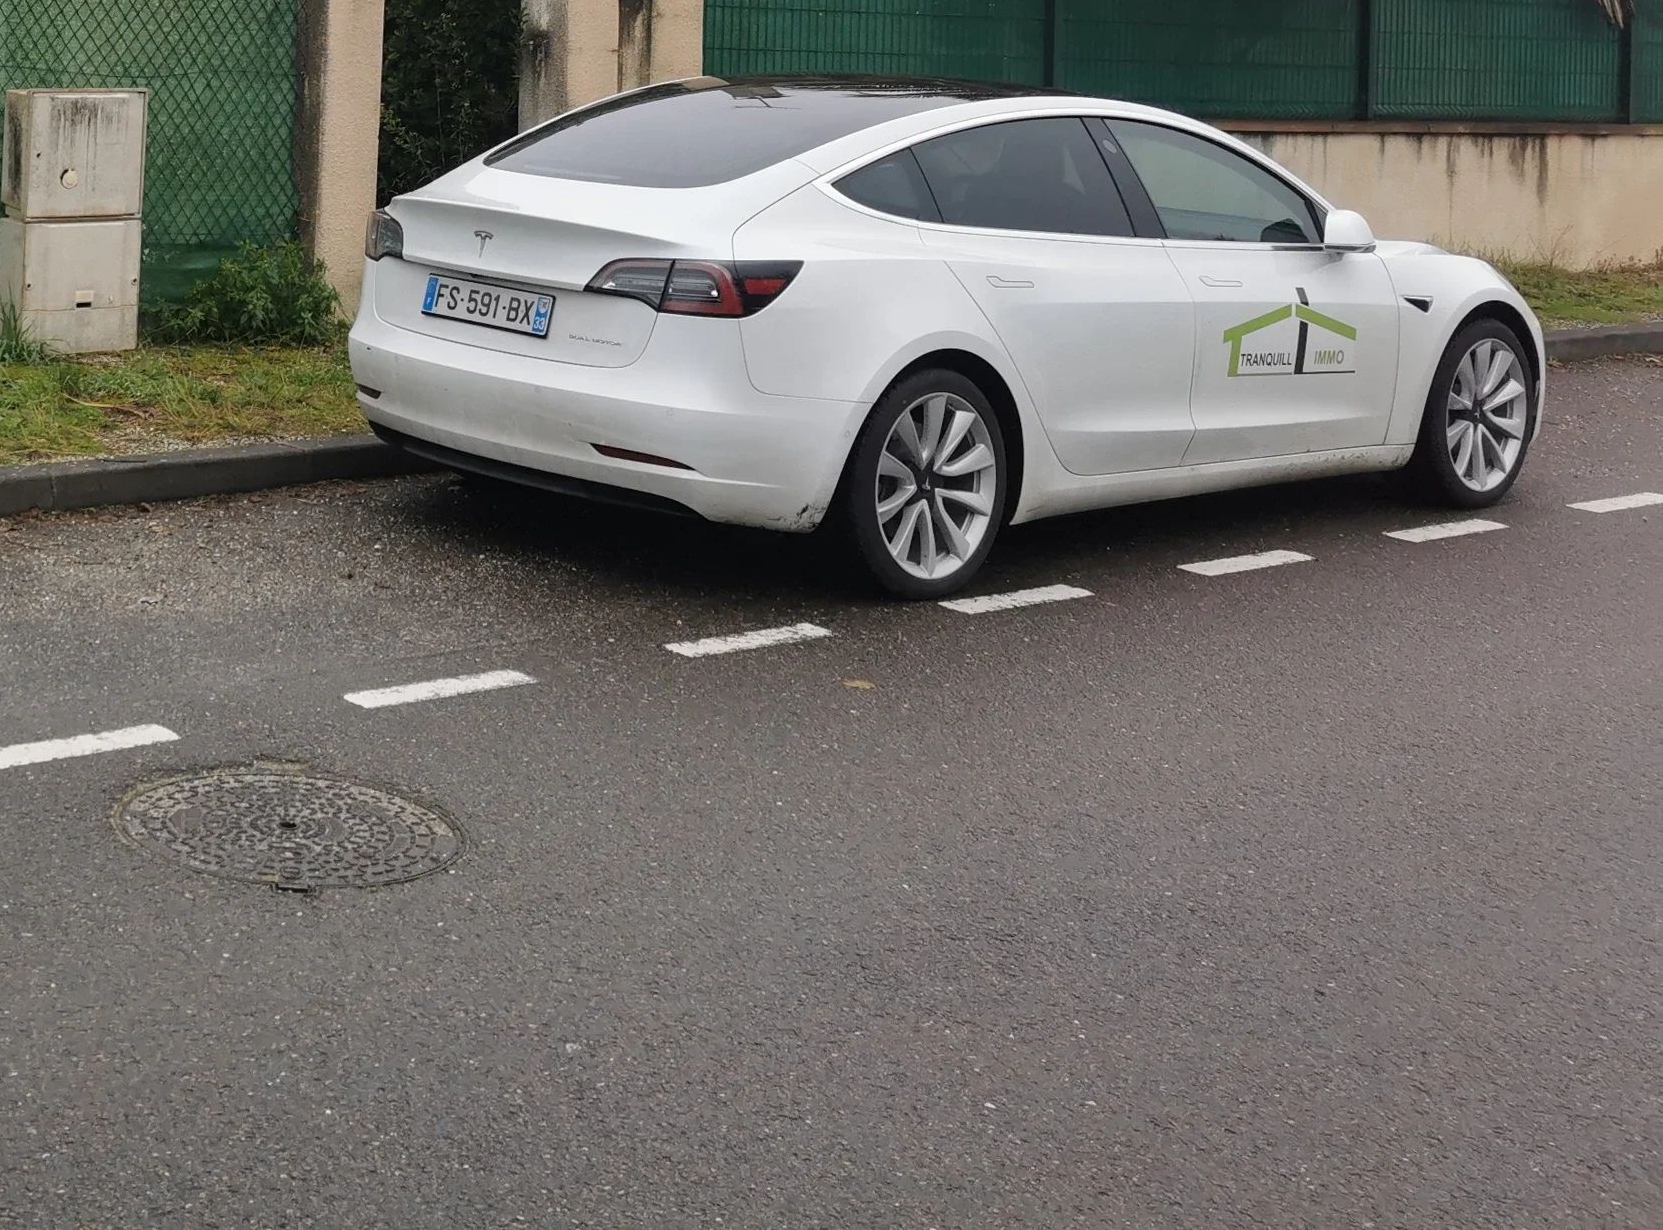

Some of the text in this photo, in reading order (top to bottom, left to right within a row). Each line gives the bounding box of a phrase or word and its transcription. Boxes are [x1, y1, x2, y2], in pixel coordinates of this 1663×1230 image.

[533, 316, 545, 330] 33
[1240, 350, 1344, 367] TRANQUILL IMMO
